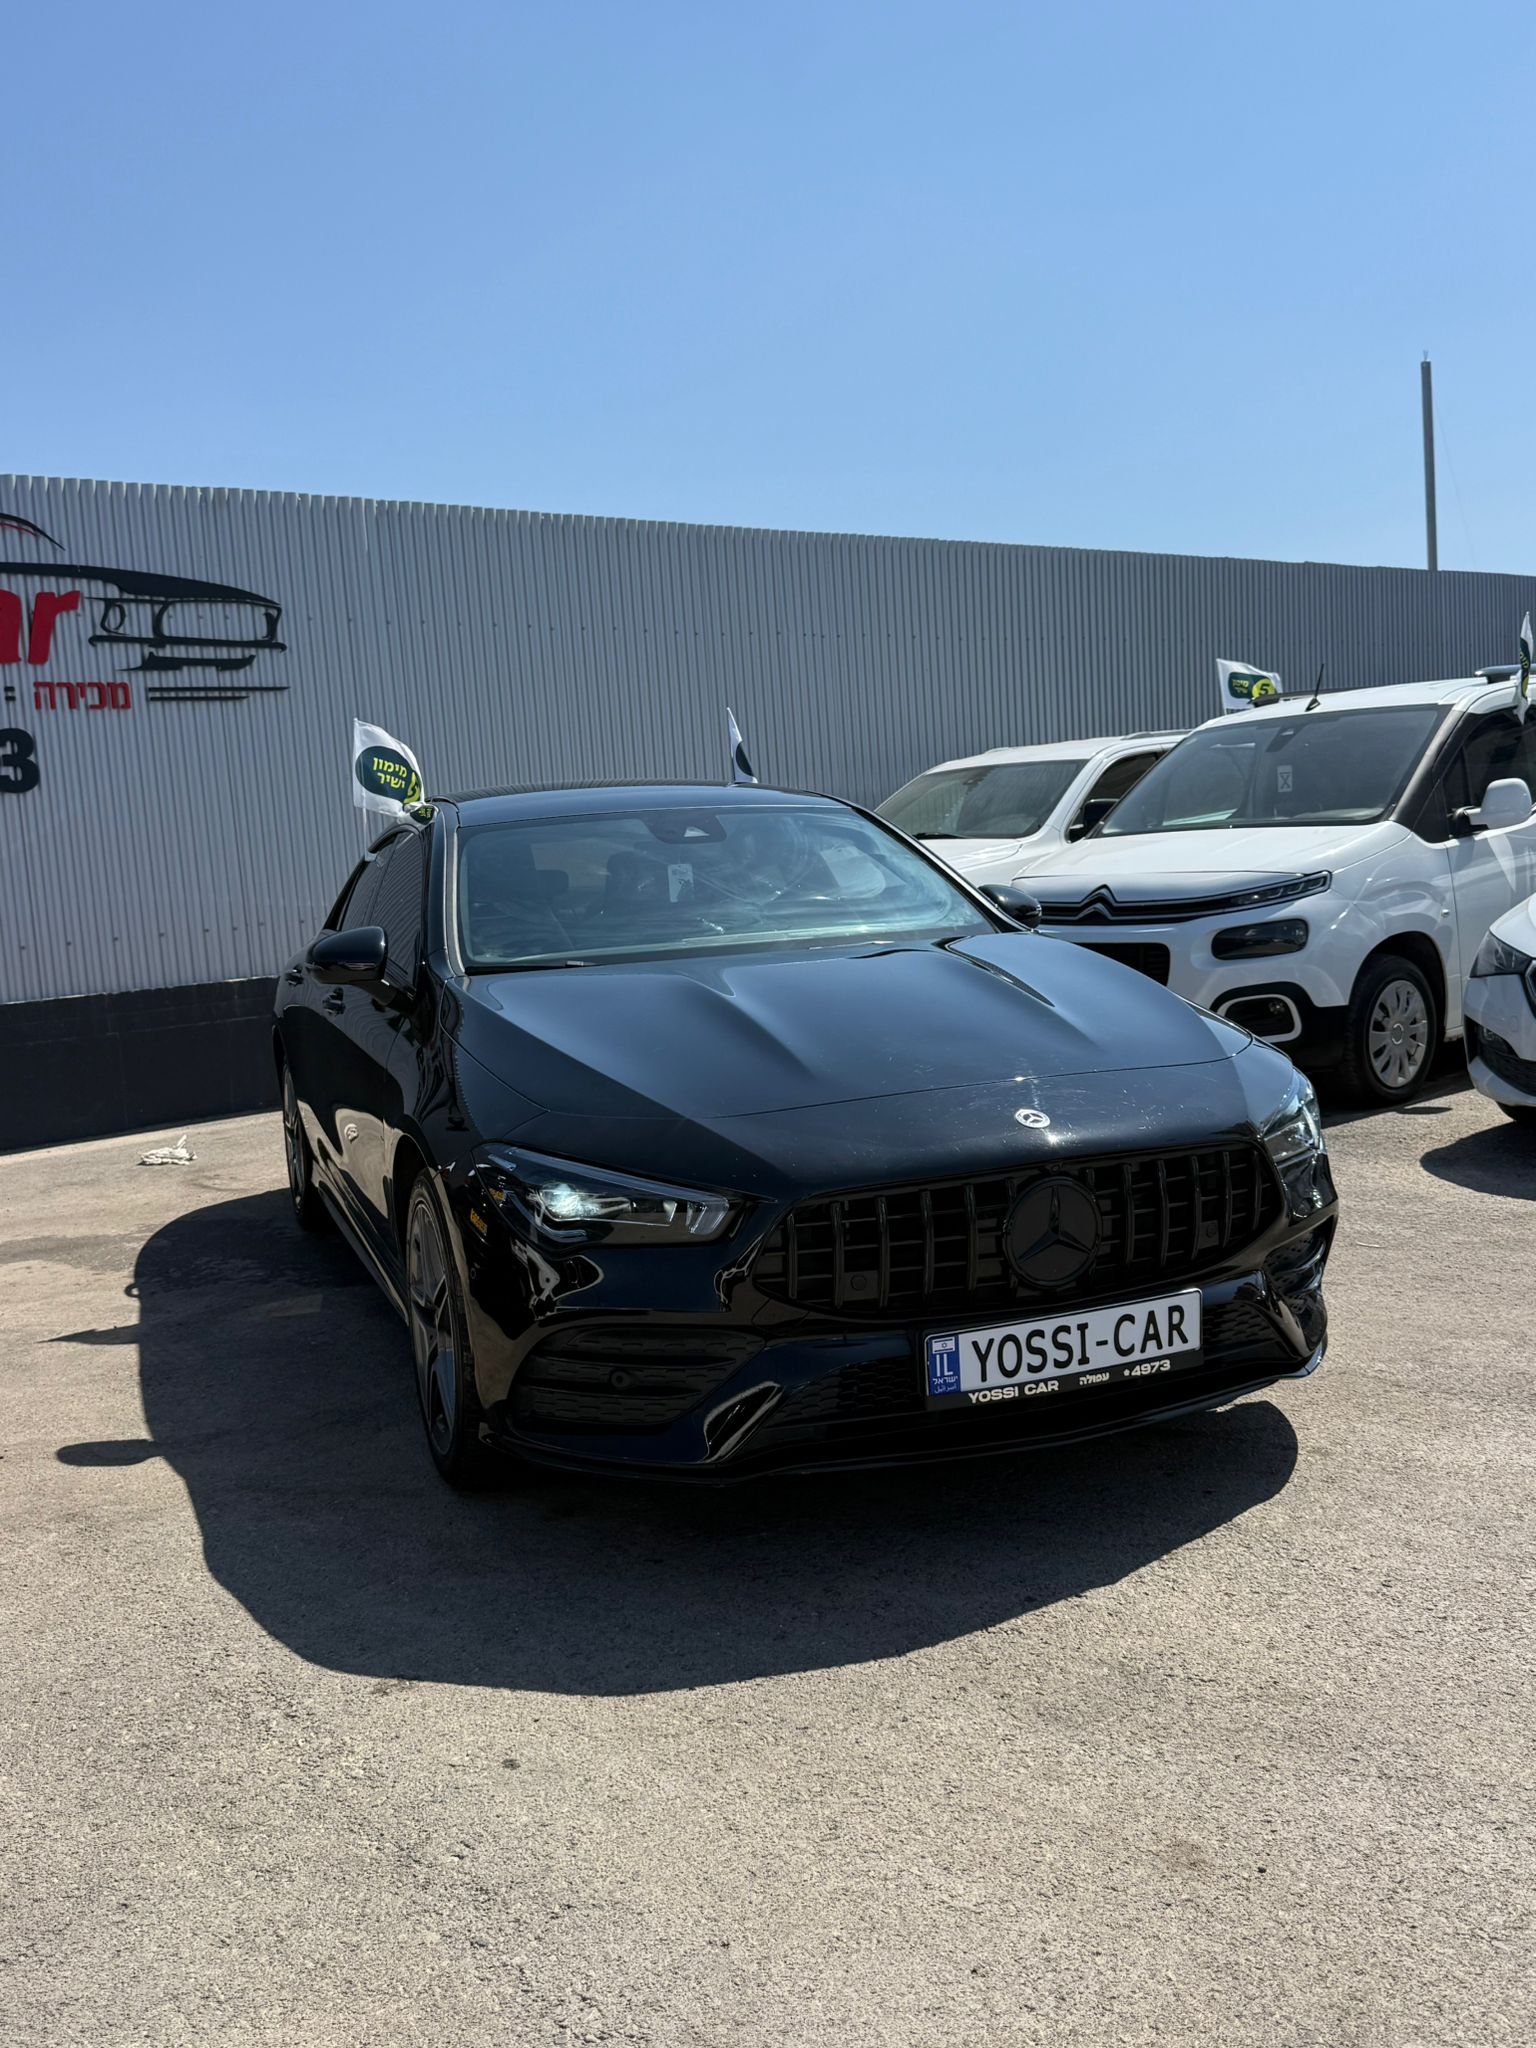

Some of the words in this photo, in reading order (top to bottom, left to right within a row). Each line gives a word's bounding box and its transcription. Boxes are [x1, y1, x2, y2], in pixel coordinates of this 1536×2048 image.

[34, 681, 132, 711] מכירה
[373, 757, 407, 778] מימון
[377, 772, 406, 789] ישיר
[971, 1305, 1189, 1383] YOSSI-CAR
[936, 1353, 954, 1377] IL
[932, 1376, 958, 1385] ישראל
[968, 1386, 1019, 1405] YOSSI
[1024, 1380, 1059, 1396] CAR
[1079, 1371, 1110, 1386] עפולה
